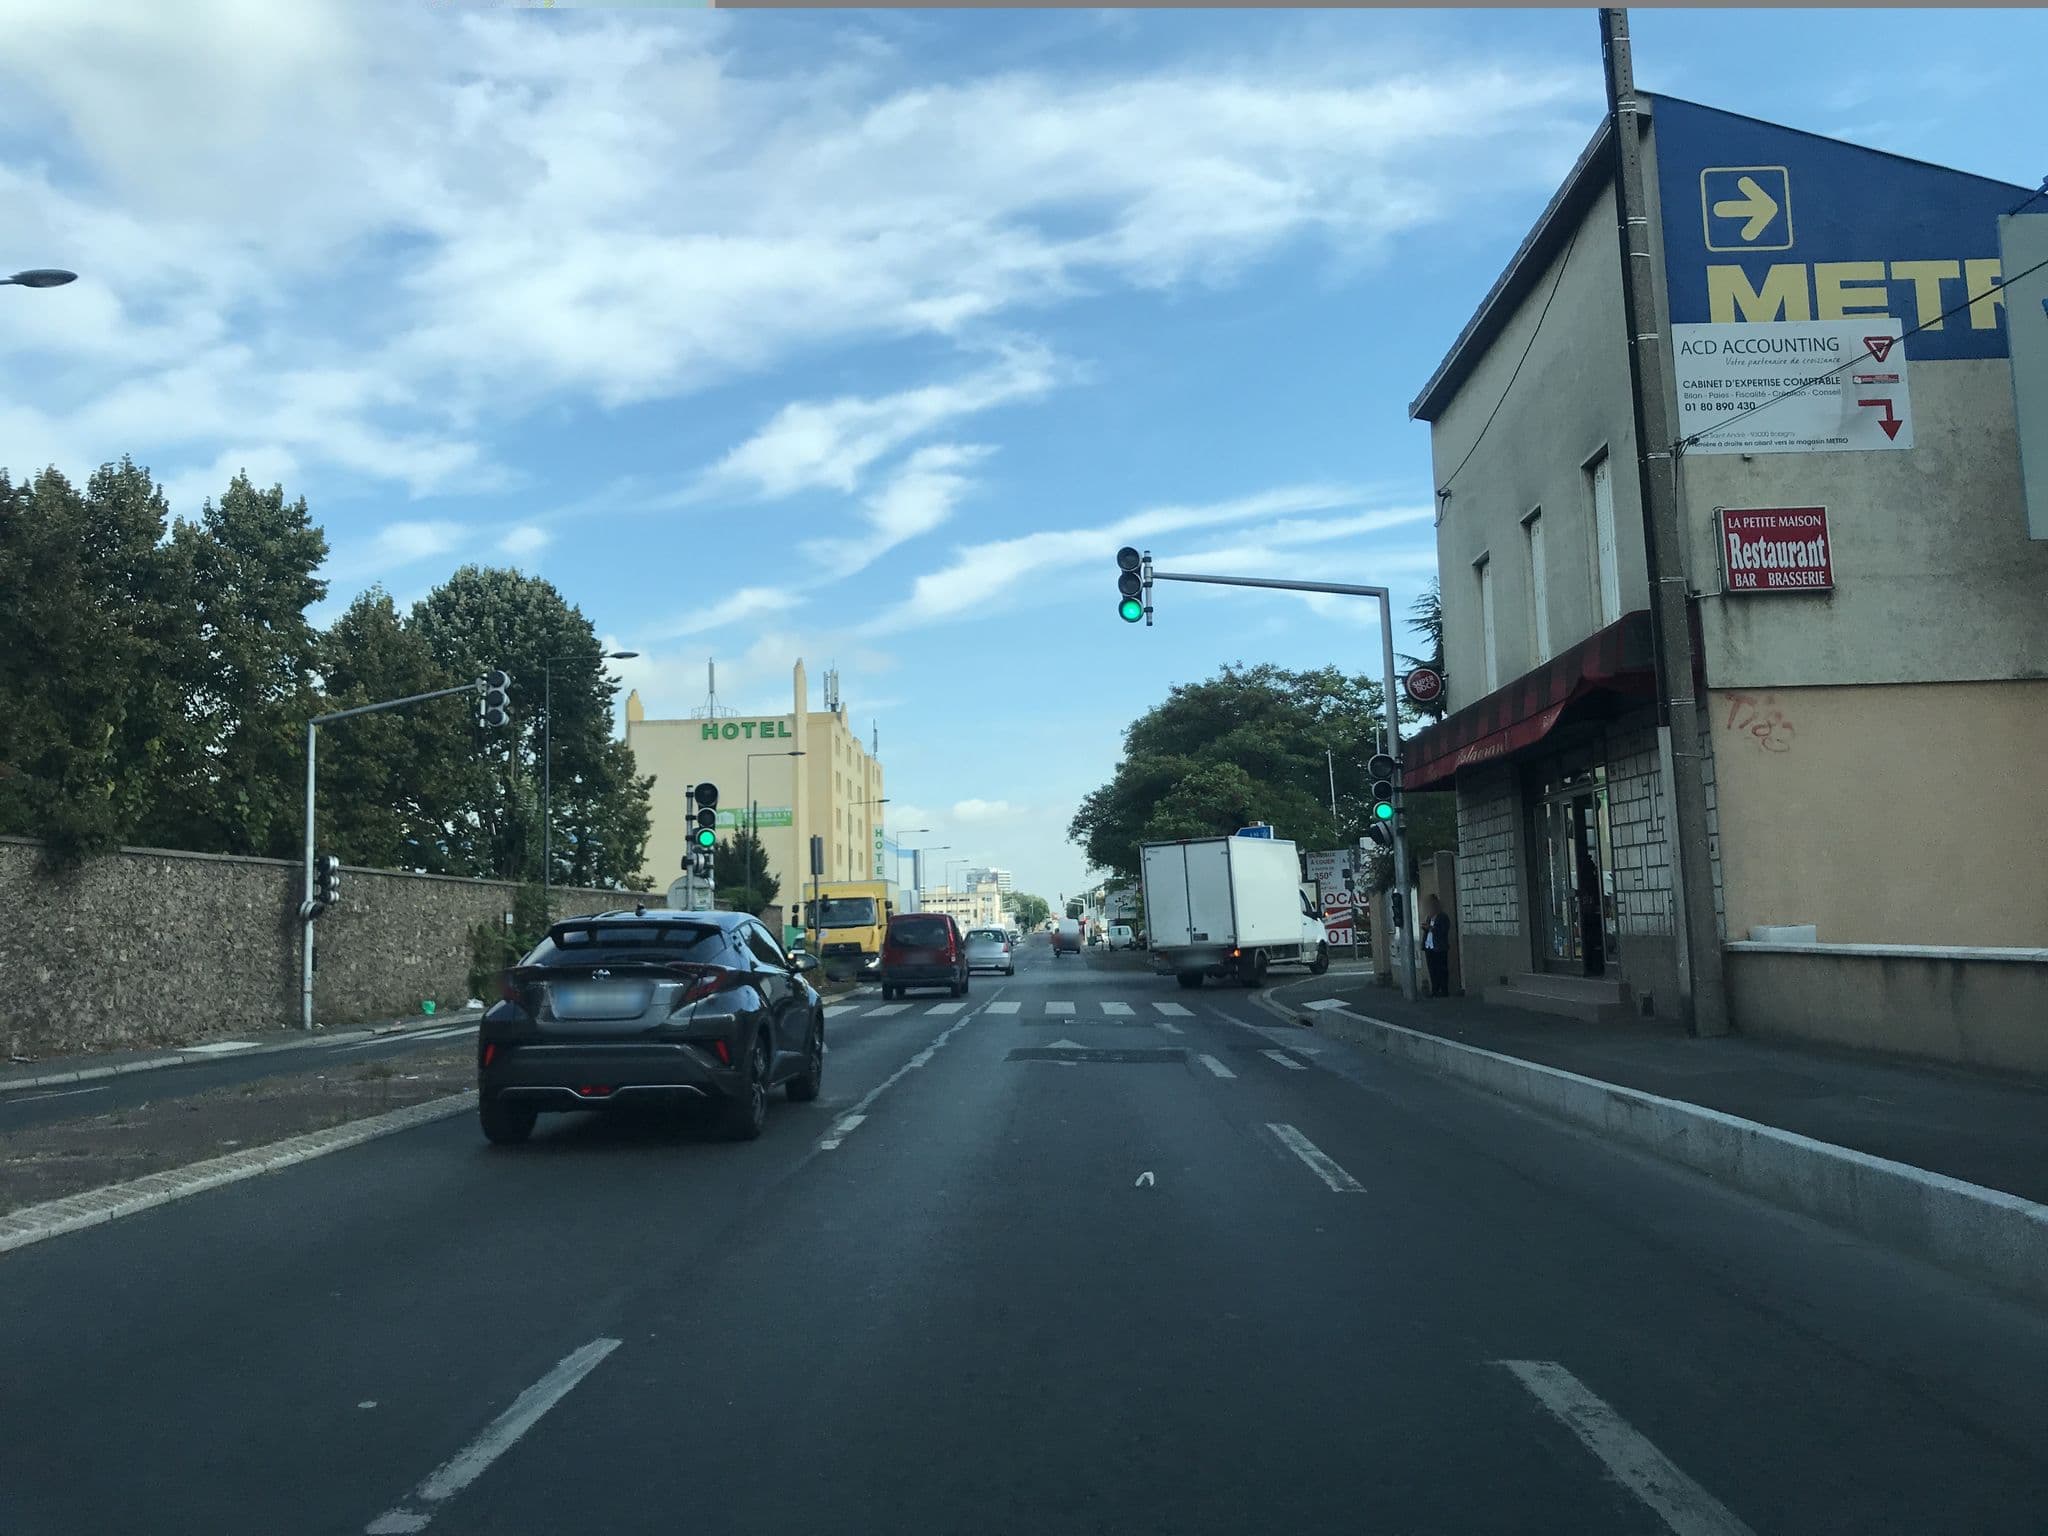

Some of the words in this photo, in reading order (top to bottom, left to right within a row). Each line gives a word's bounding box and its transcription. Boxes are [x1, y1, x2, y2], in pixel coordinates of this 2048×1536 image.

[1680, 339, 1717, 355] ACD
[1722, 337, 1840, 354] ACCOUNTING
[1725, 356, 1745, 366] Votre
[1746, 357, 1787, 367] partenaire
[1790, 356, 1800, 364] de
[1801, 356, 1841, 364] croissance
[1682, 379, 1723, 389] CABINET
[1725, 378, 1781, 388] D'EXPERTISE
[1783, 376, 1841, 387] COMPTABLE
[1735, 390, 1767, 398] Fiscalité
[1812, 388, 1841, 396] Conseil
[1685, 402, 1696, 412] 01
[1700, 402, 1713, 411] 80
[1715, 401, 1735, 411] 890
[1737, 401, 1756, 411] 430
[1727, 517, 1741, 529] LA
[1743, 516, 1776, 528] PETITE
[1778, 515, 1821, 528] MAISON
[1728, 532, 1827, 570] Restaurant
[1735, 573, 1757, 587] BAR
[1768, 571, 1826, 586] BRASSERIE
[702, 720, 792, 741] HOTEL
